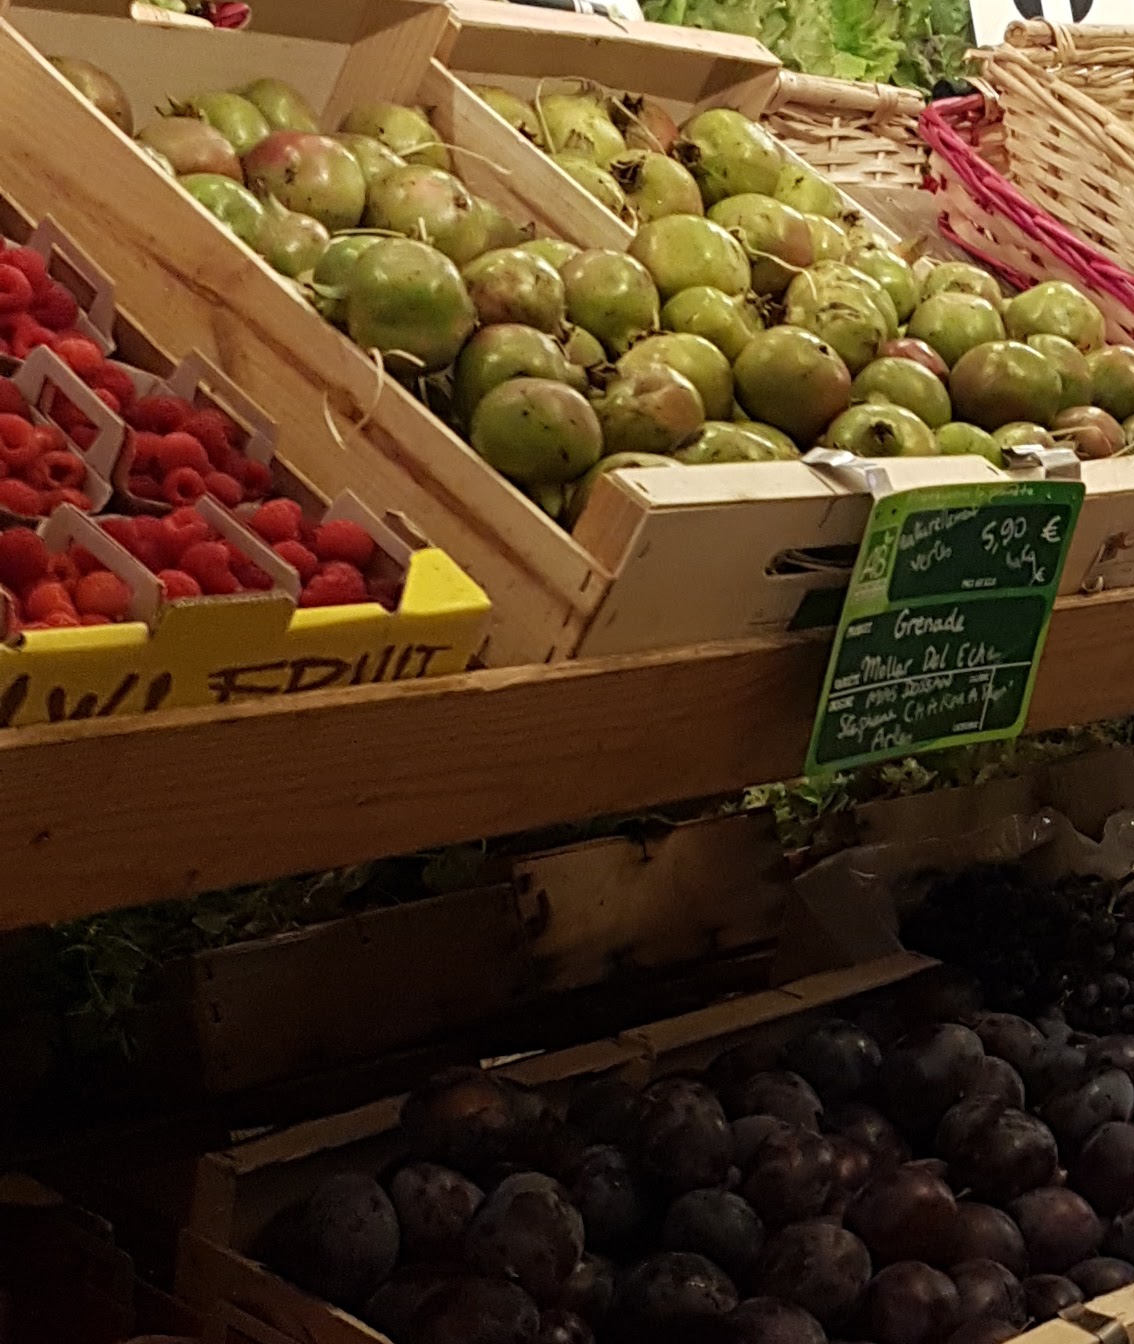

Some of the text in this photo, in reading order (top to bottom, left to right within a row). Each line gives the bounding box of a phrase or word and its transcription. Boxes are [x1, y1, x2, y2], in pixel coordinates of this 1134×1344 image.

[980, 515, 1028, 555] 5,90
[1040, 514, 1063, 544] €
[894, 607, 967, 640] Grenade
